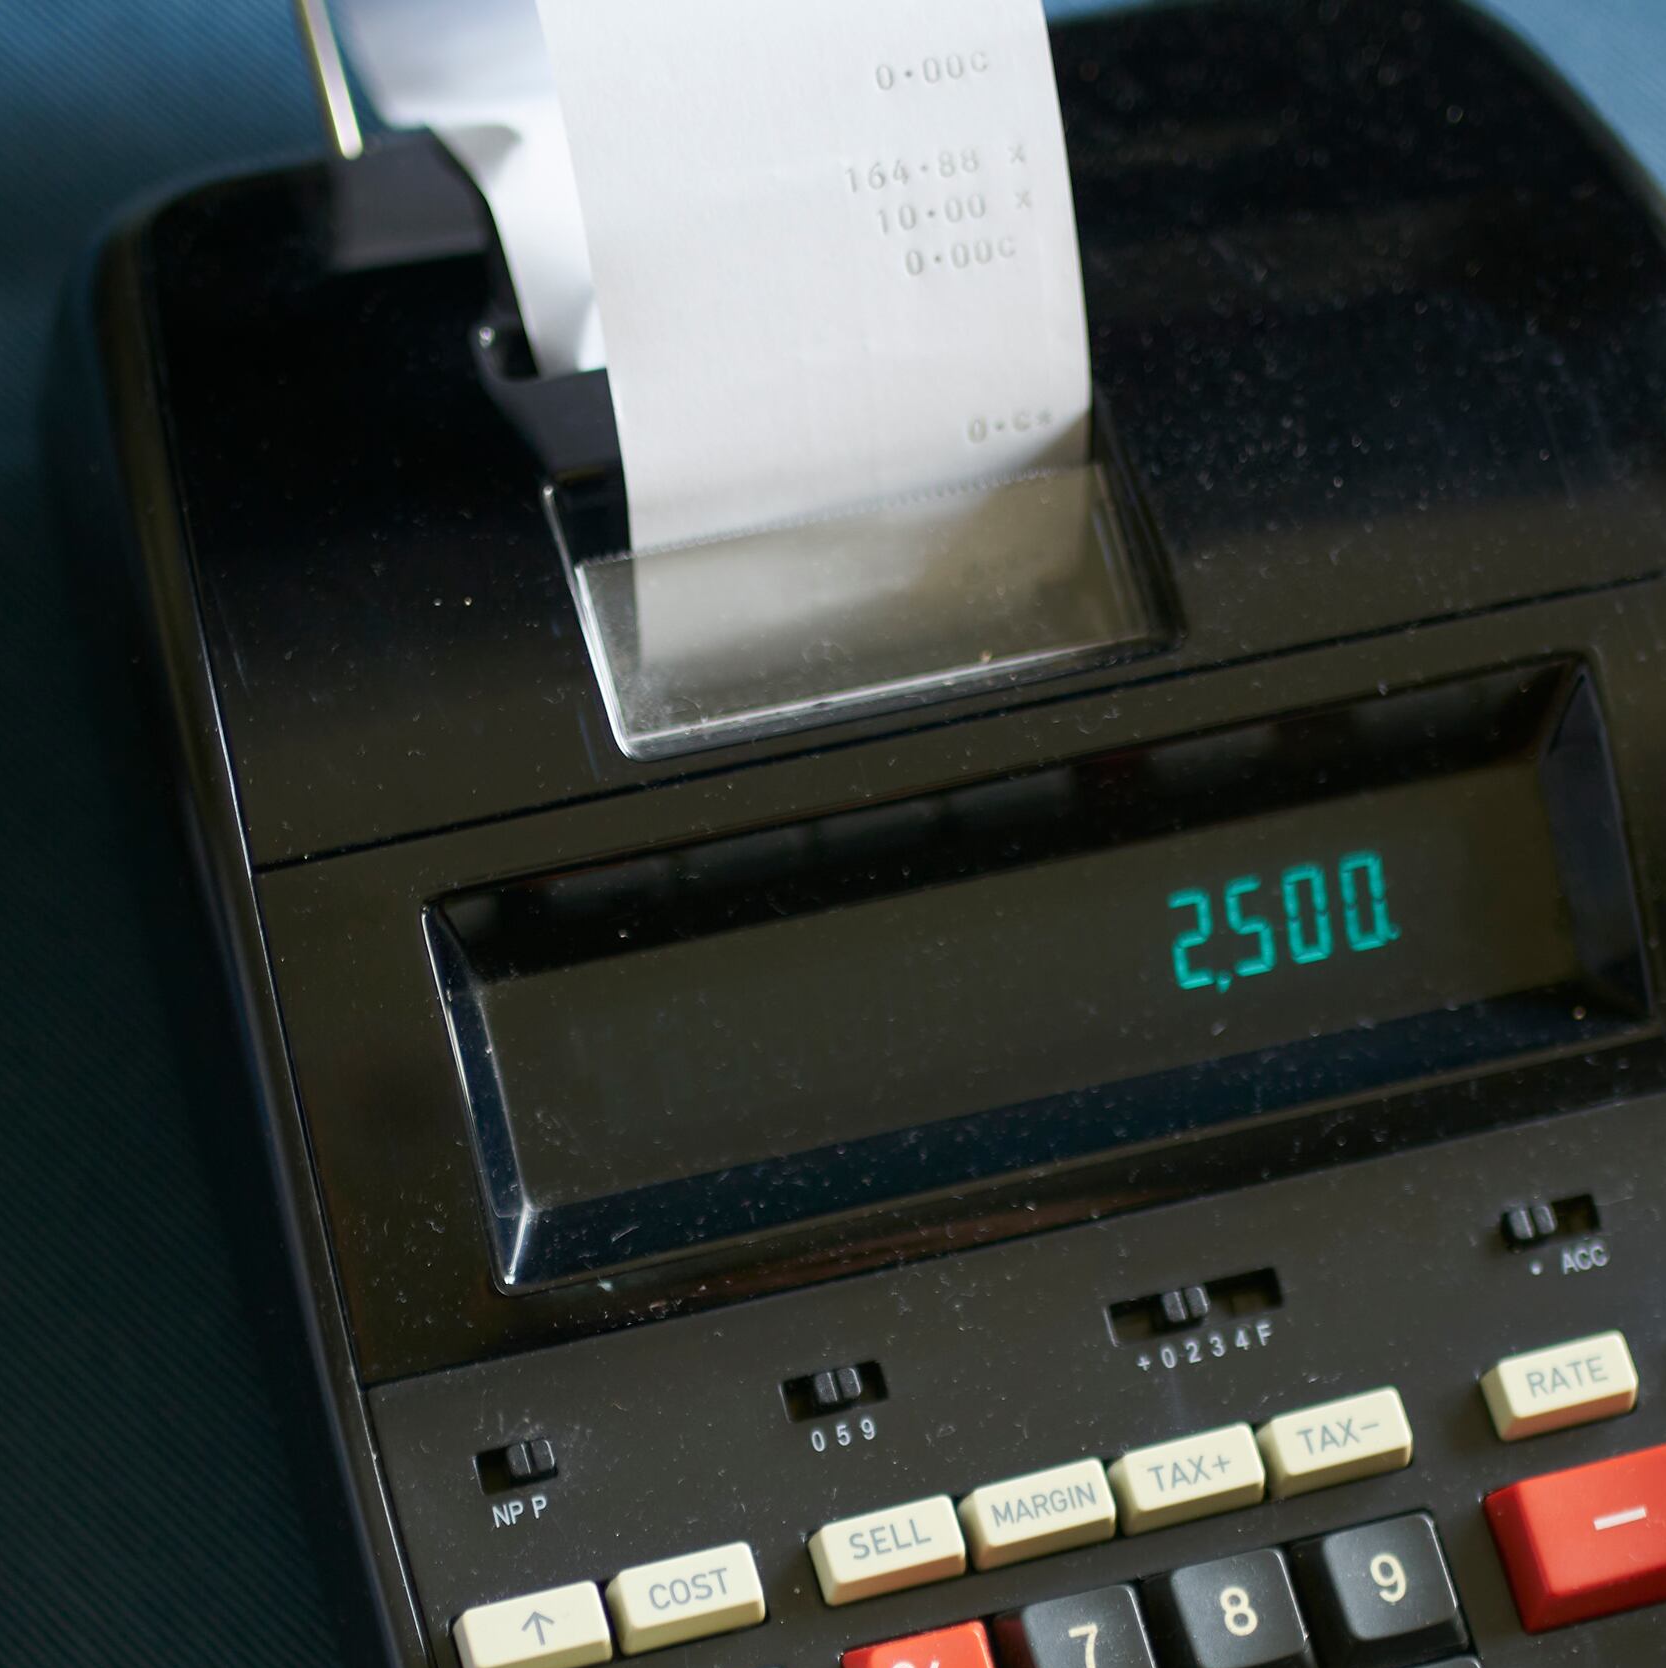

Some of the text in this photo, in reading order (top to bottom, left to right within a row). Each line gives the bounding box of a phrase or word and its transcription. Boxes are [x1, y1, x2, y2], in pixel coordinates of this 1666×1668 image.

[1561, 1244, 1611, 1277] ACC
[1527, 1356, 1609, 1399] RATE
[1147, 1453, 1233, 1493] TAX+
[991, 1482, 1098, 1528] MARGIN
[848, 1518, 932, 1561] SELL
[648, 1568, 731, 1611] COST
[1369, 1553, 1408, 1603] 9
[1219, 1586, 1258, 1636] 8
